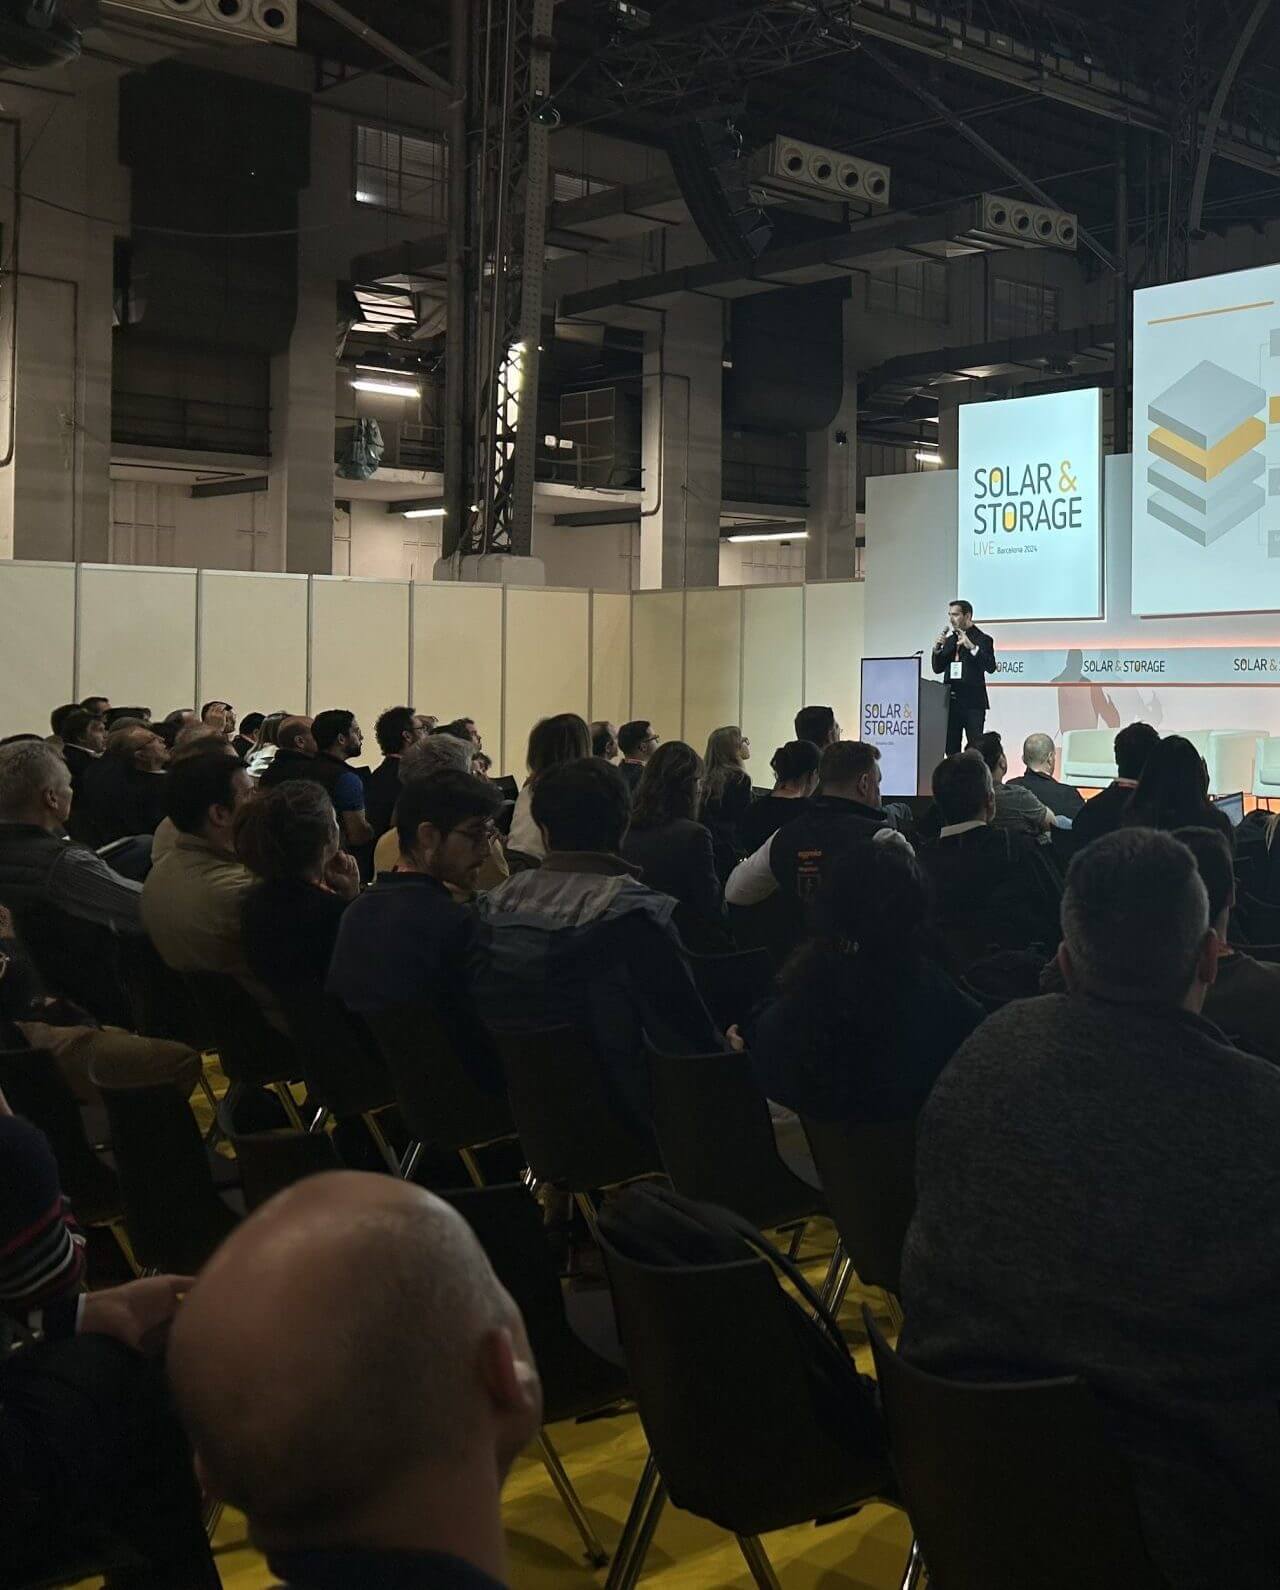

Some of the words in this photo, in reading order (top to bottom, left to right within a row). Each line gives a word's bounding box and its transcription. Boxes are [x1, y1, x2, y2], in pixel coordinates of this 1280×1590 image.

[974, 463, 1052, 499] SOLAR
[1058, 460, 1077, 493] &
[974, 496, 1082, 535] STORAGE
[974, 540, 995, 557] LIVE
[997, 546, 1024, 554] Barcelona
[1024, 545, 1038, 553] 2024
[996, 661, 1024, 673] ORAGE
[1083, 660, 1113, 673] SOLAR
[1114, 660, 1122, 672] &
[1123, 660, 1166, 673] STORAGE
[1233, 658, 1268, 672] SOLAR
[1269, 658, 1278, 672] &
[864, 704, 901, 719] SOLAR
[903, 704, 912, 719] &
[864, 720, 914, 736] STORAGE
